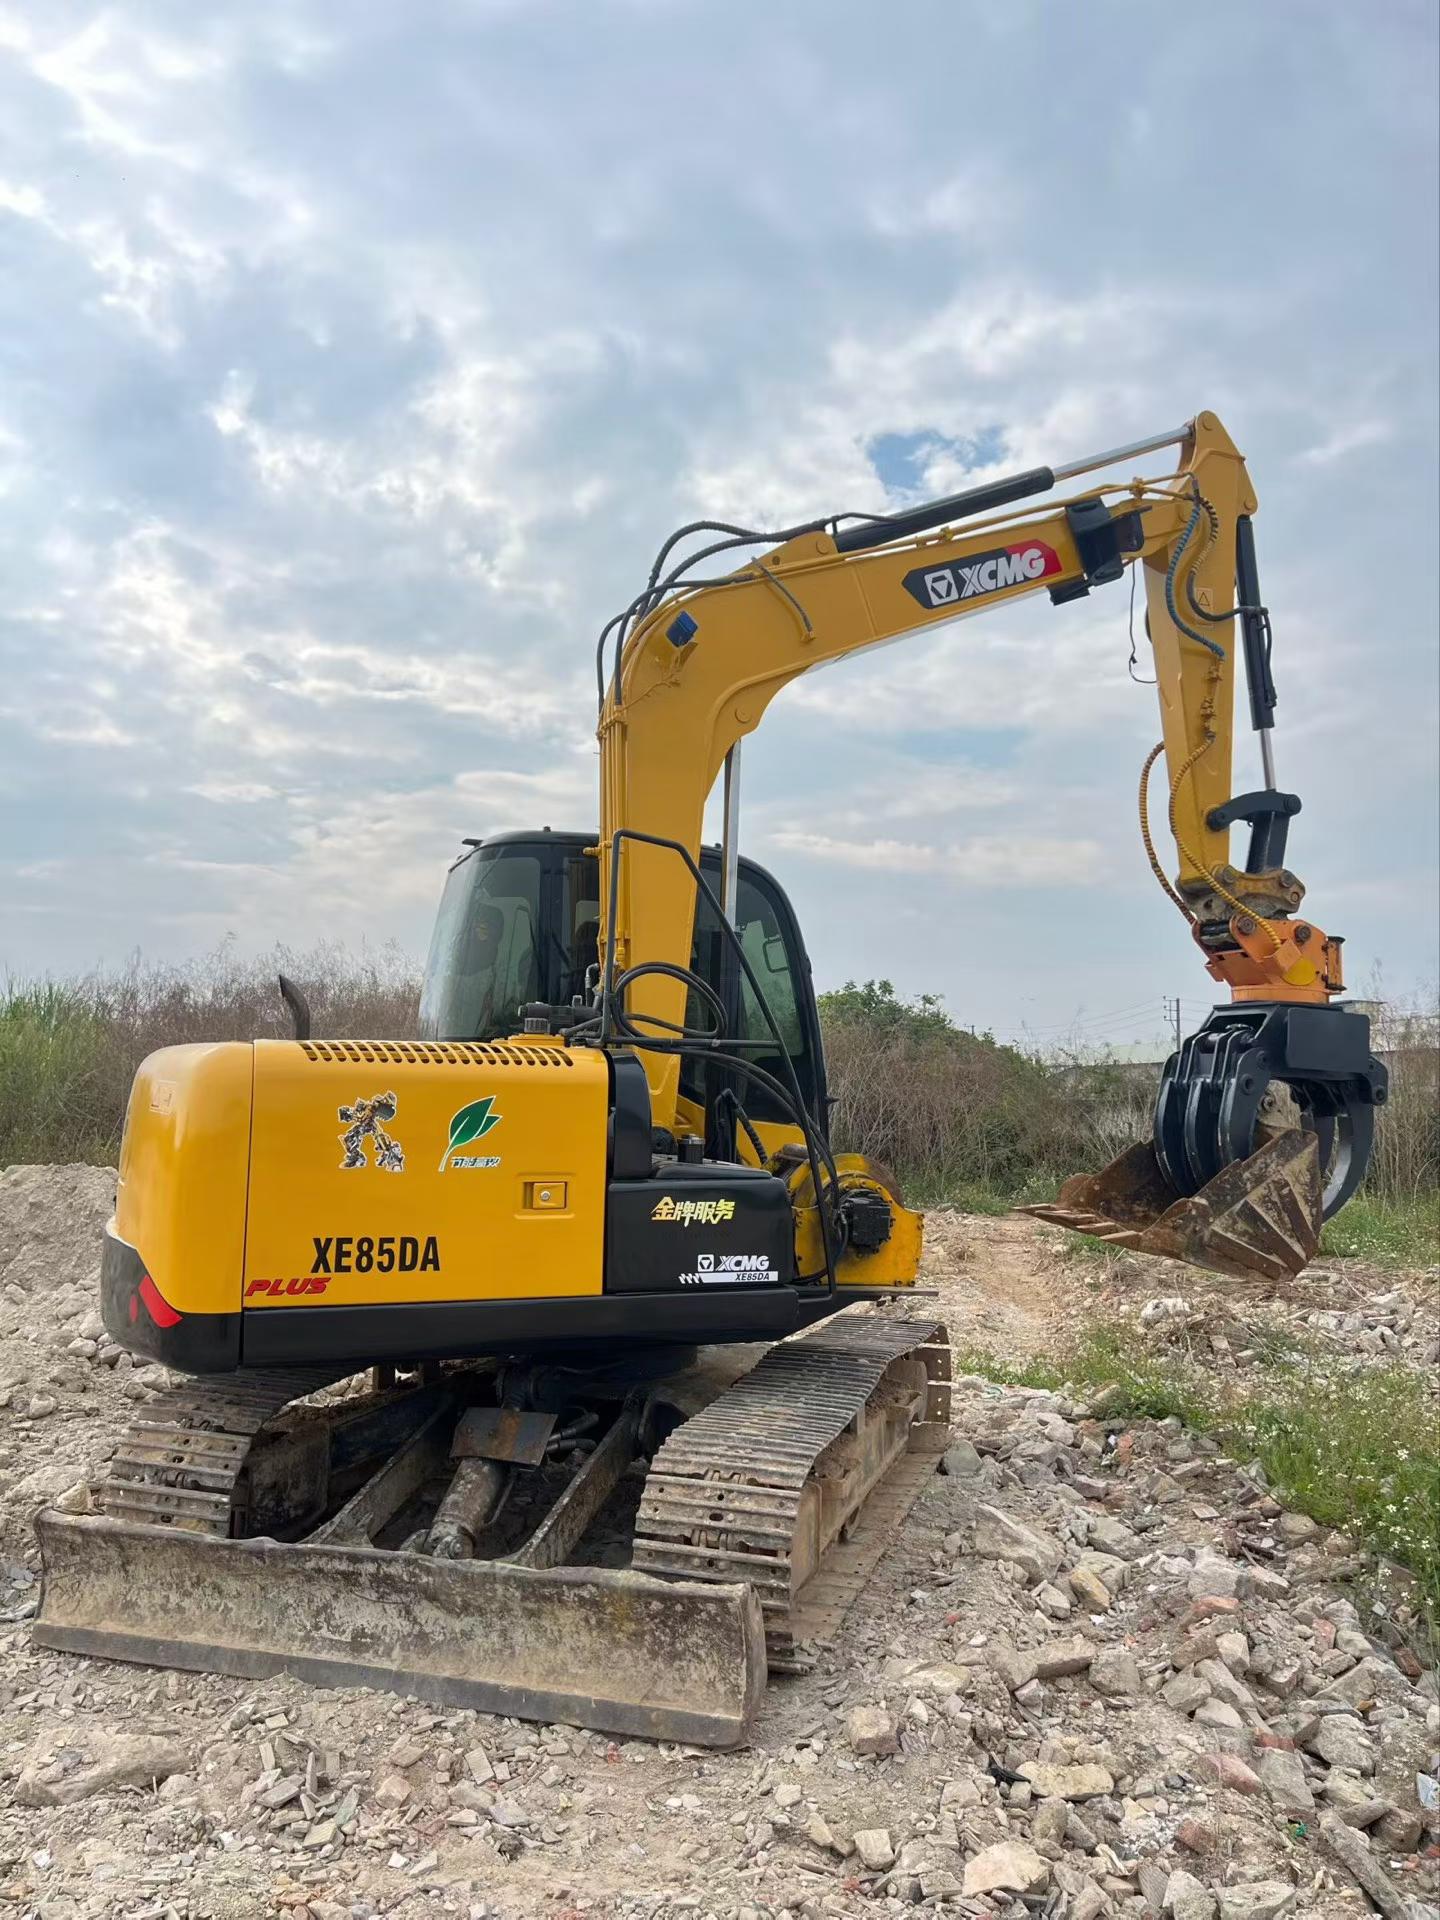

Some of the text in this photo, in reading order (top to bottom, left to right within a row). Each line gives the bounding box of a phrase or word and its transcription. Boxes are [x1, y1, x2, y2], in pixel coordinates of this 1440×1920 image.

[957, 548, 1046, 599] XCMG
[651, 1196, 736, 1227] 金牌服务
[310, 1236, 440, 1274] XE85DA
[715, 1255, 770, 1271] XCMG
[244, 1276, 332, 1297] PLUS
[735, 1272, 770, 1281] XE85DA
